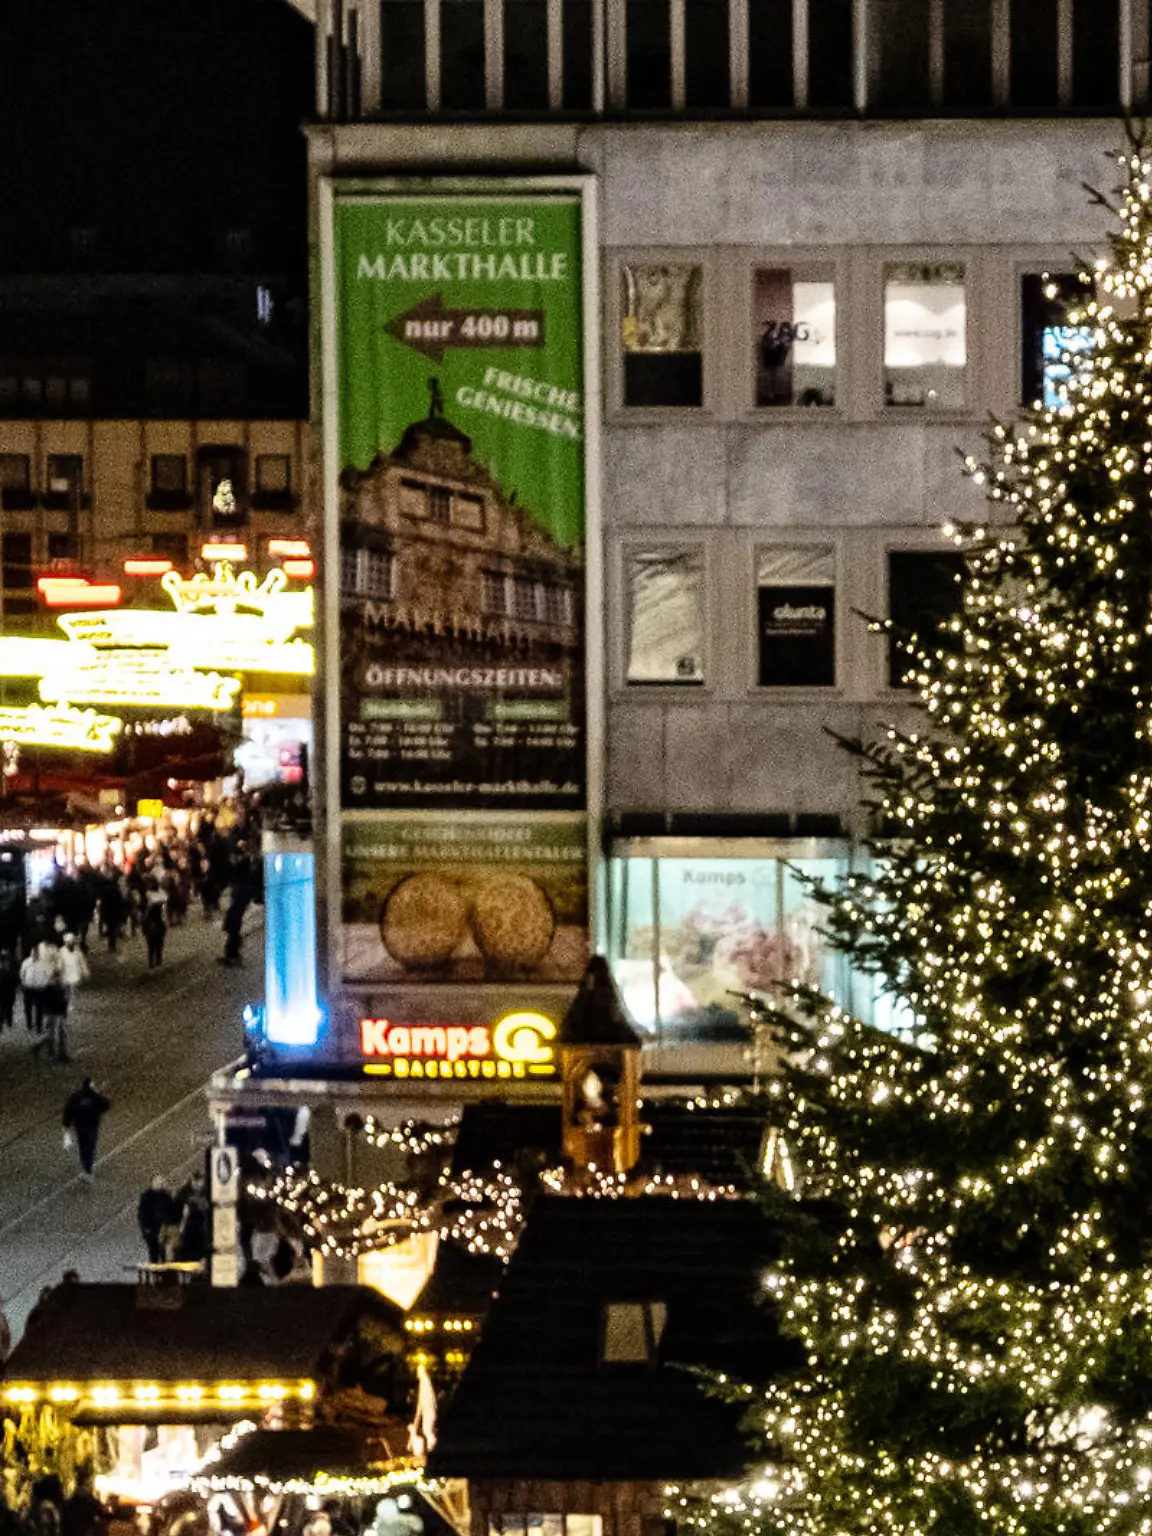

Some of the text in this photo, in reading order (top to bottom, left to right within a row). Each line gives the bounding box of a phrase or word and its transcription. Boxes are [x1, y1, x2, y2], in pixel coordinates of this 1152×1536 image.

[386, 216, 536, 247] KASSELER
[356, 253, 570, 280] MARKTHALLE
[404, 314, 539, 340] nur 400 m
[483, 366, 580, 413] FRISCHE
[364, 664, 564, 686] ÖFFNUNGSZEITEN:
[683, 867, 747, 886] Kamps
[361, 1018, 491, 1061] Kamps
[393, 1058, 527, 1078] BACKSTUBE
